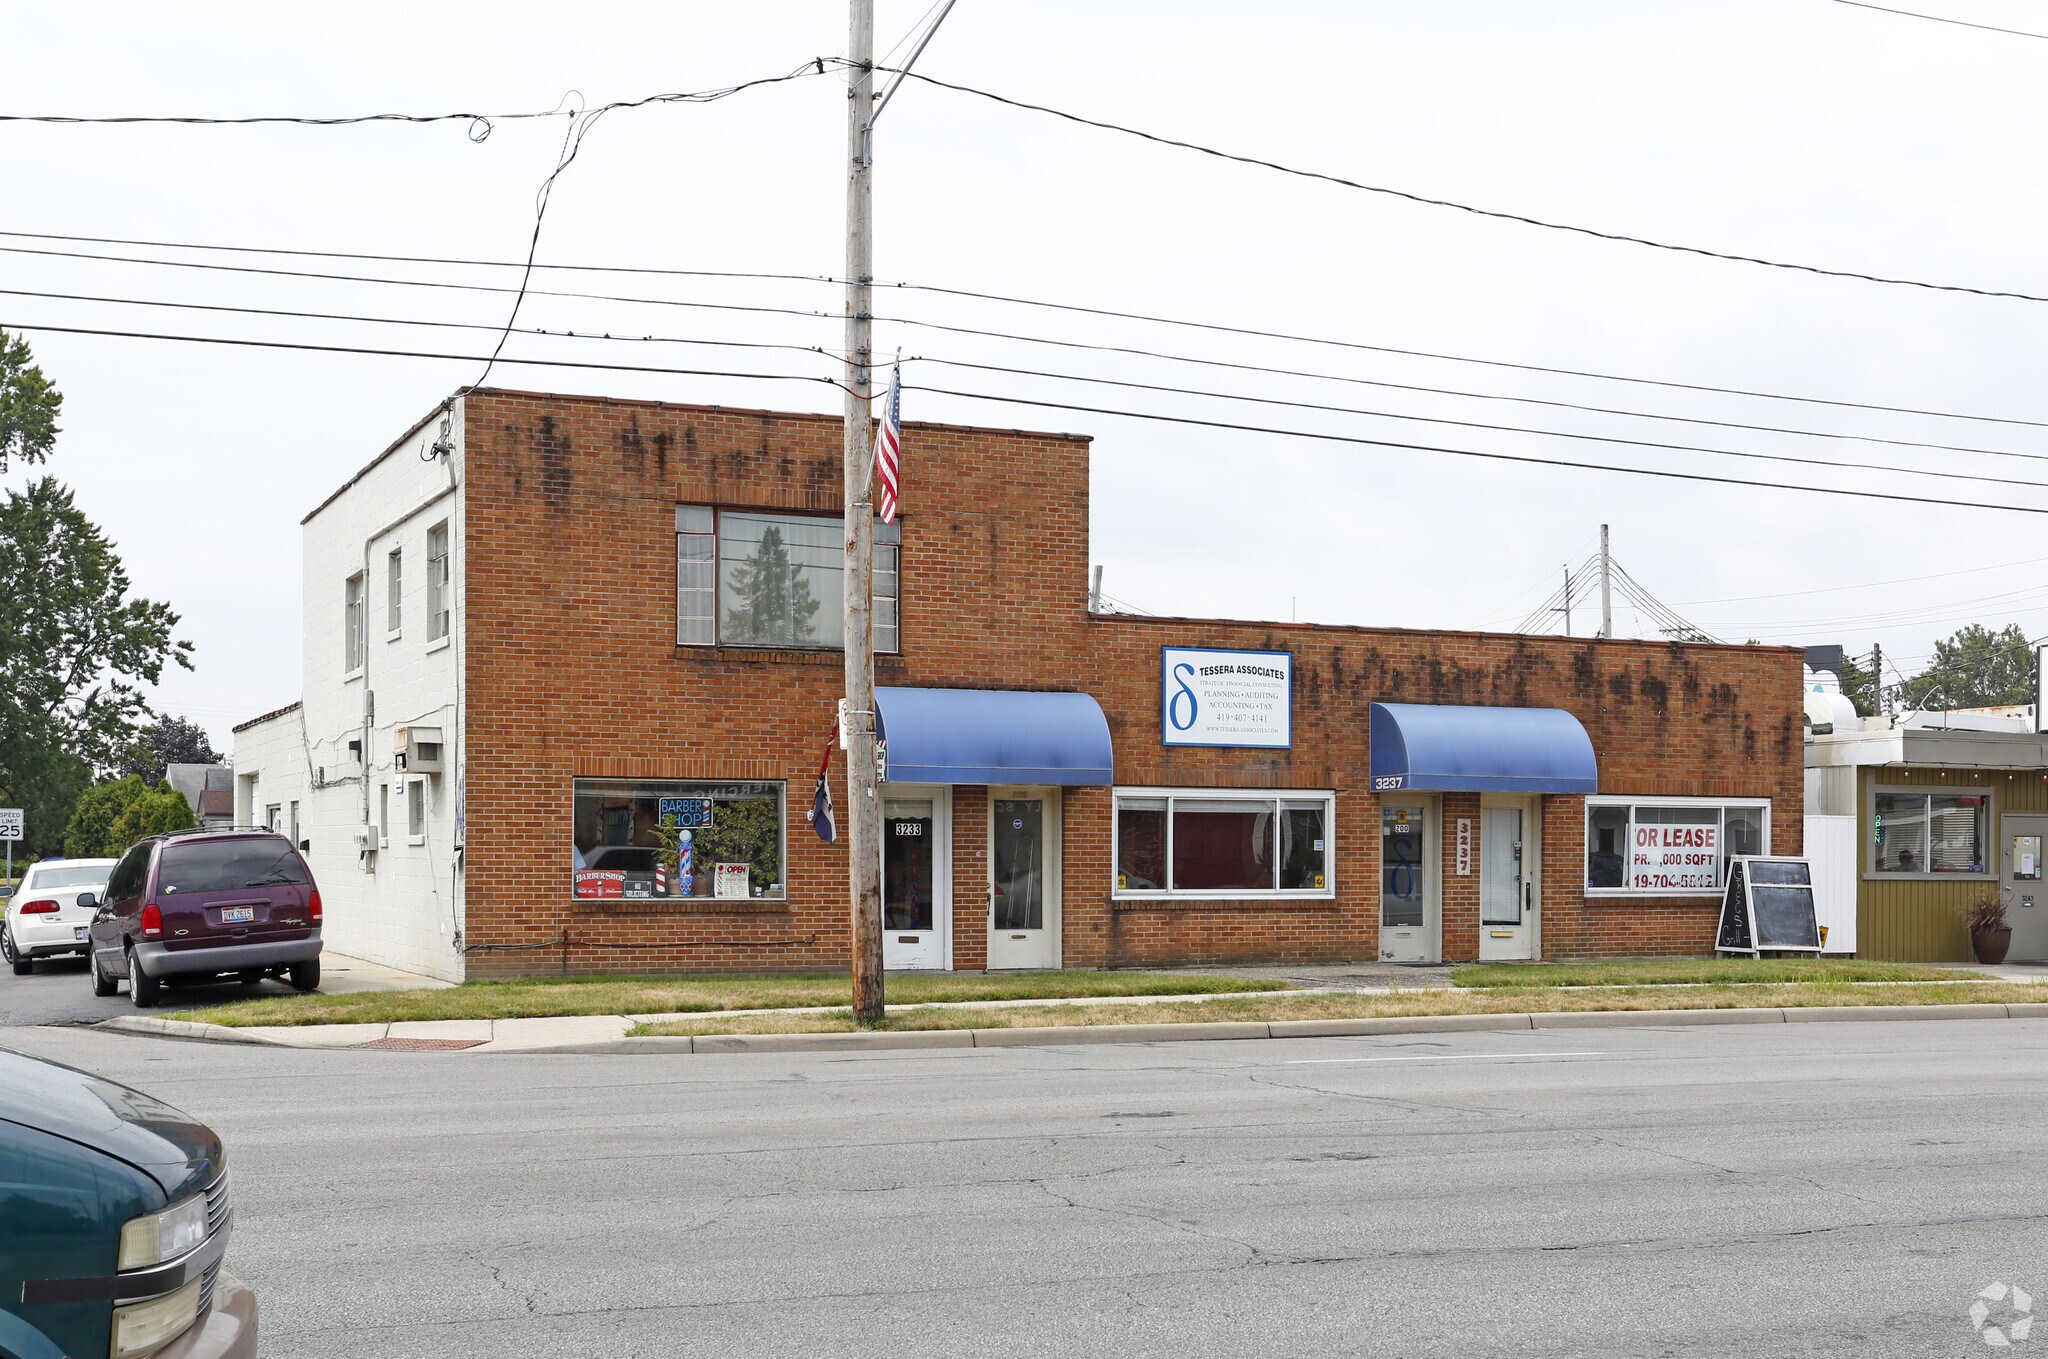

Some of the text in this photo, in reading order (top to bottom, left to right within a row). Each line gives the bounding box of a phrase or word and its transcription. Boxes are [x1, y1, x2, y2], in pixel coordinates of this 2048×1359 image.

[1199, 665, 1285, 680] TESSERA ASSOCIATES
[1252, 681, 1283, 689] CONSULTING
[1203, 690, 1279, 700] PLANNING AUDITING
[1208, 702, 1255, 710] ACCOUNTING
[1216, 713, 1268, 723] 419-407-4141
[1375, 776, 1403, 790] 3237
[661, 799, 702, 813] BARBER
[0, 825, 20, 837] 25
[896, 824, 921, 835] 3233
[1635, 828, 1715, 848] OR LEASE
[1634, 853, 1650, 865] PR.
[1685, 853, 1714, 866] SQFT
[726, 865, 747, 874] OPEN
